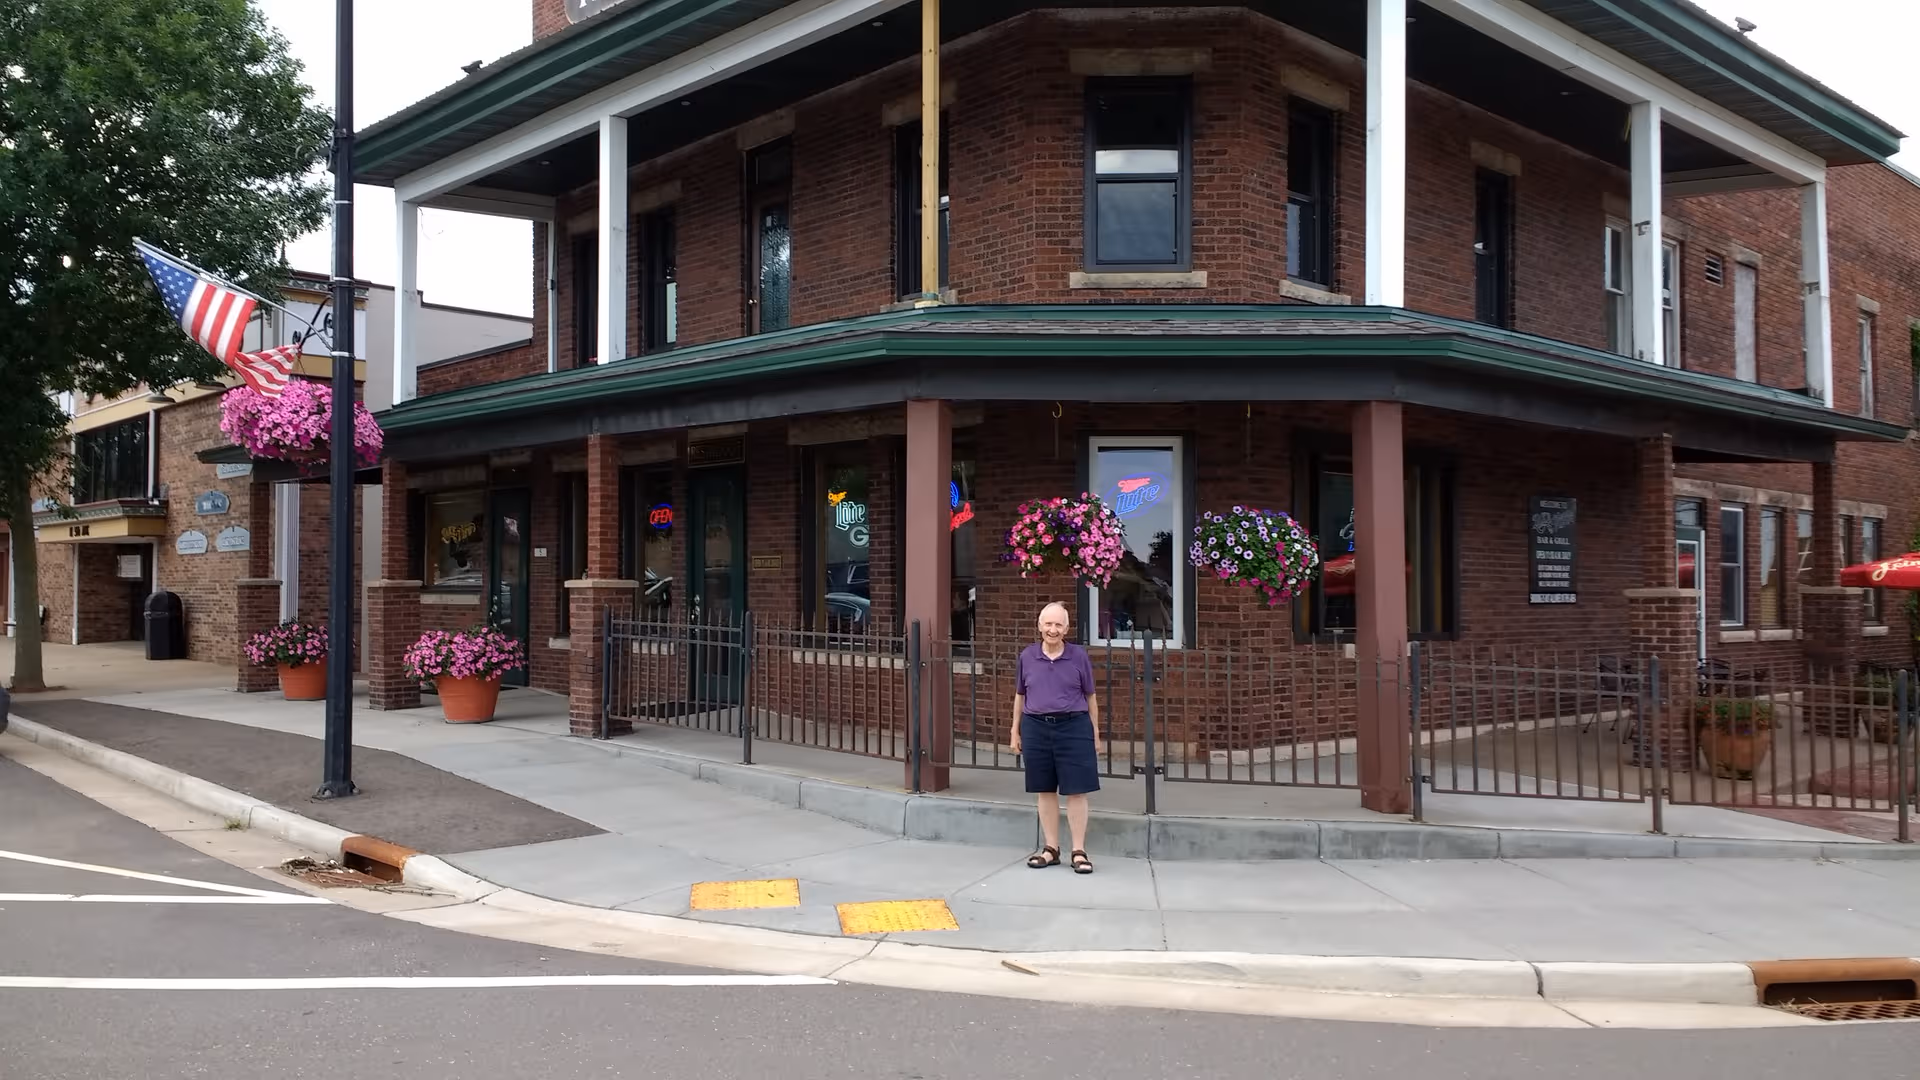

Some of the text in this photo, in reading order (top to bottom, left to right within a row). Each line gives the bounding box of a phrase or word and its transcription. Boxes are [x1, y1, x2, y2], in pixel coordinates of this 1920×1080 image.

[1115, 484, 1160, 515] Lite
[835, 501, 866, 531] Lite
[1536, 536, 1549, 544] BAR
